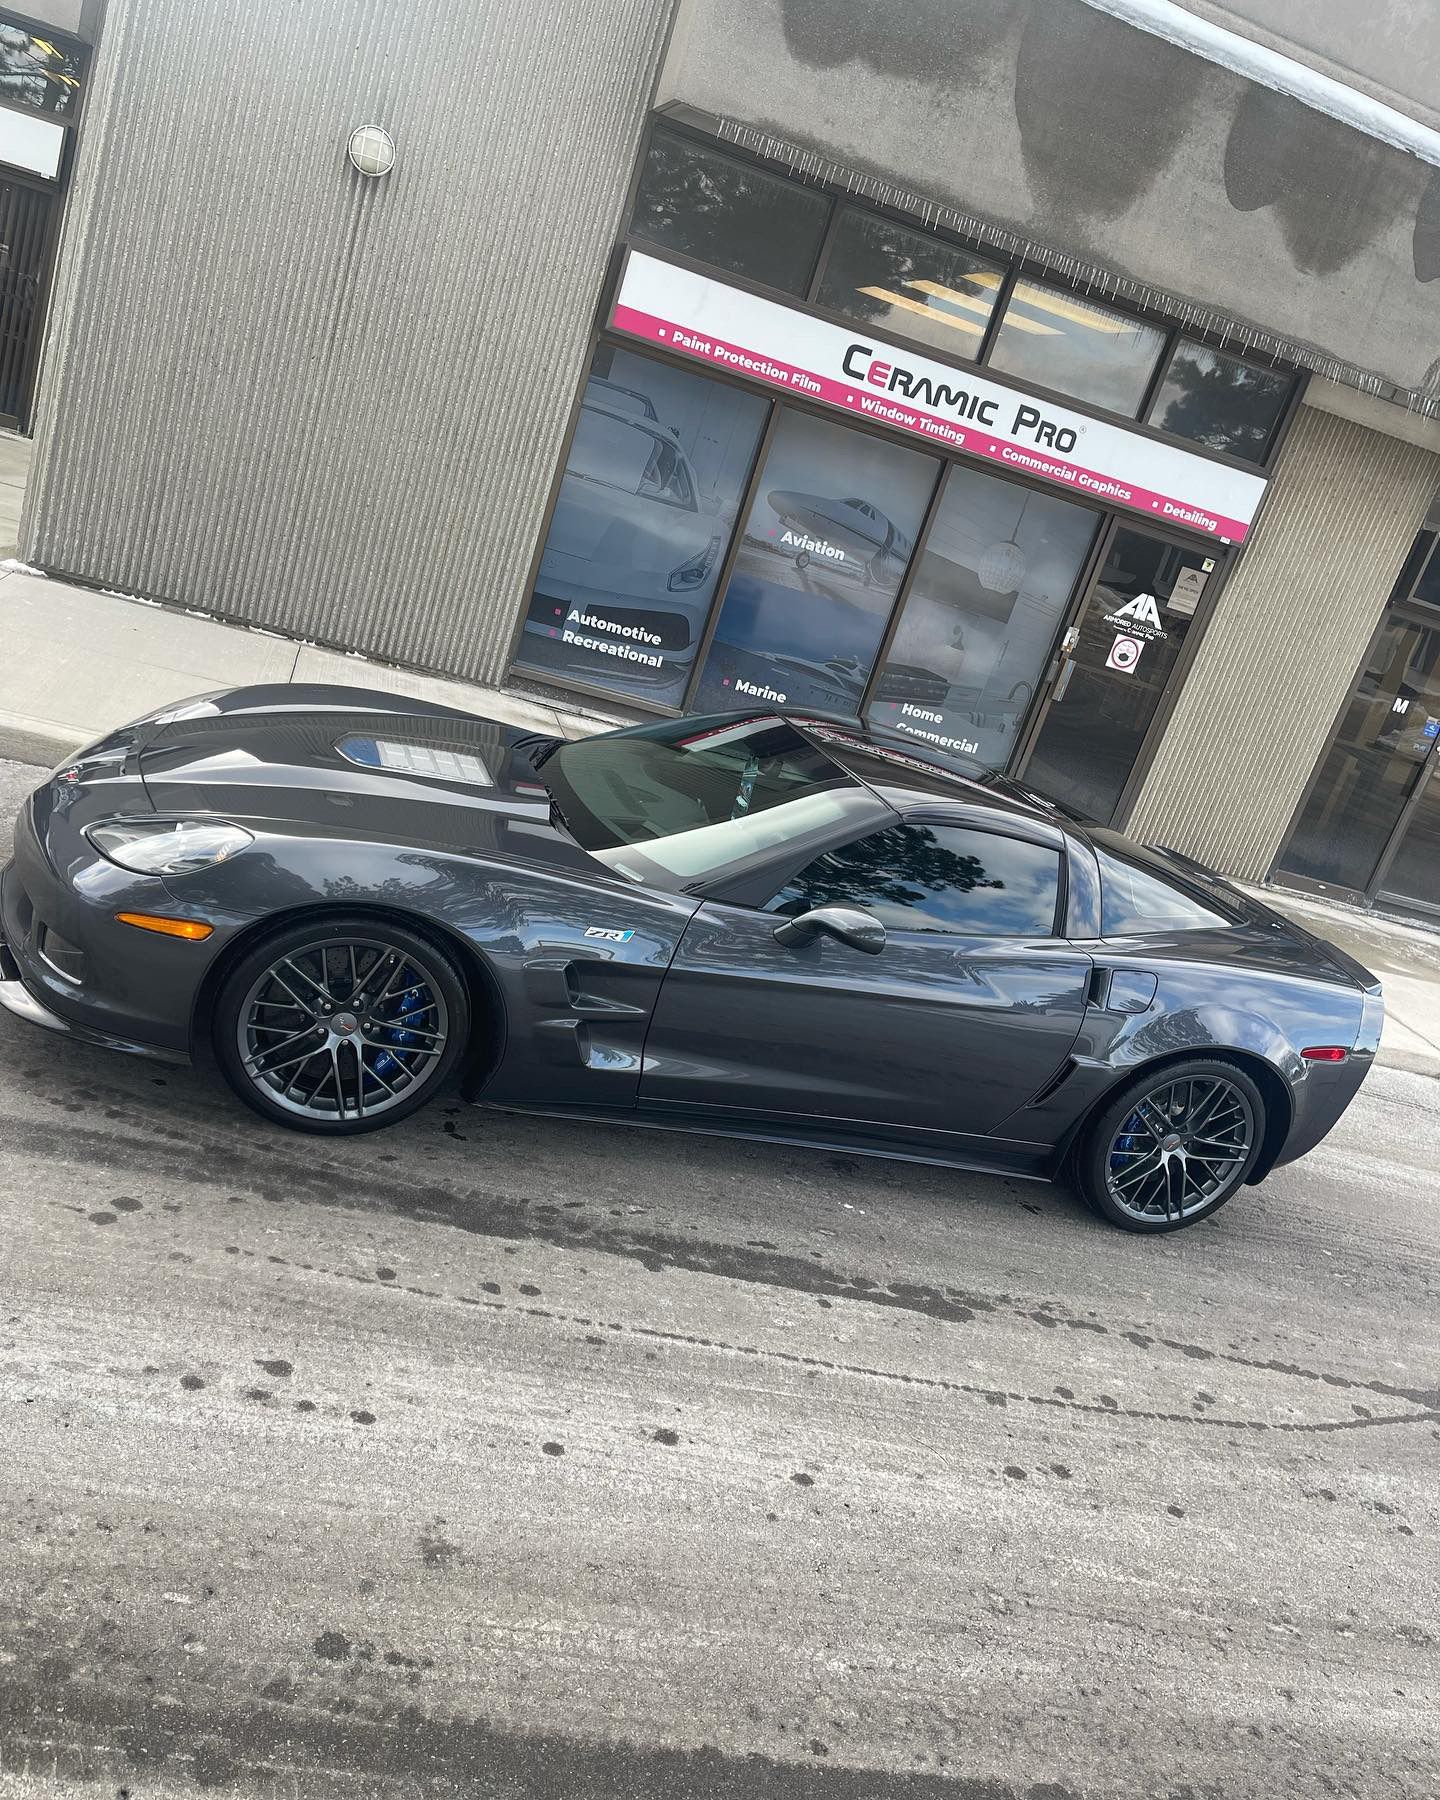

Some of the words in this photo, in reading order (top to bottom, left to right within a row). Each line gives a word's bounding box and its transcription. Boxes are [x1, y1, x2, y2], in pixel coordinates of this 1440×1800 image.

[672, 330, 711, 354] Paint
[713, 345, 789, 382] Protection
[791, 372, 822, 393] Film
[842, 344, 999, 427] CERAMIC
[1010, 403, 1077, 453] PRO
[860, 396, 916, 426] Window
[919, 417, 965, 445] Tinting
[1001, 447, 1078, 481] Commercial
[1078, 473, 1133, 500] Graphics
[1162, 502, 1218, 532] Detailing
[780, 530, 845, 561] Aviation
[567, 609, 662, 645] Automotive
[562, 629, 664, 668] Recreational
[734, 678, 787, 704] Marine
[901, 703, 943, 724] Home
[586, 928, 634, 942] ZR1
